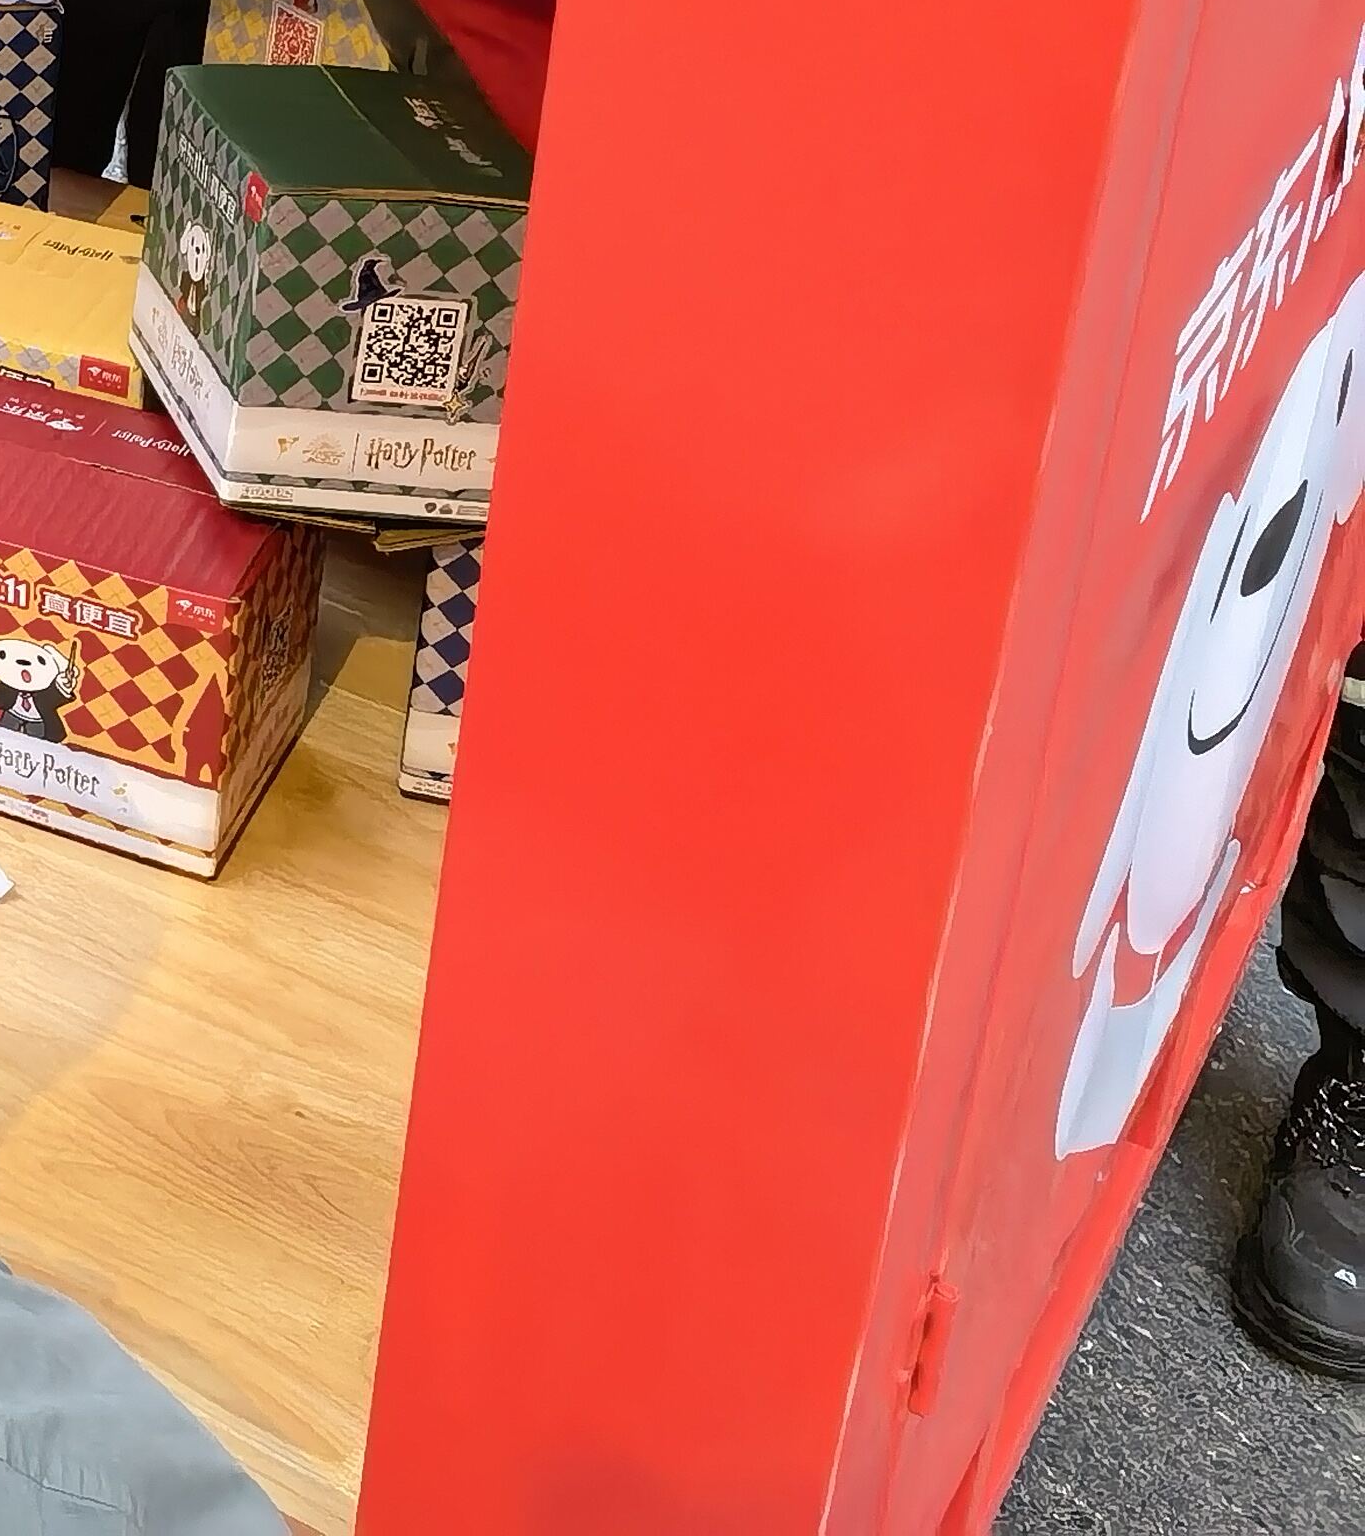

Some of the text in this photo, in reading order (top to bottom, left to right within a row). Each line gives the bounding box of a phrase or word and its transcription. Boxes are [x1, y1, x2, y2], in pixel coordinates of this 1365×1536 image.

[364, 436, 419, 471] Harry
[419, 437, 477, 477] Potter
[41, 590, 137, 639] 真便宜
[41, 751, 101, 798] Potter
